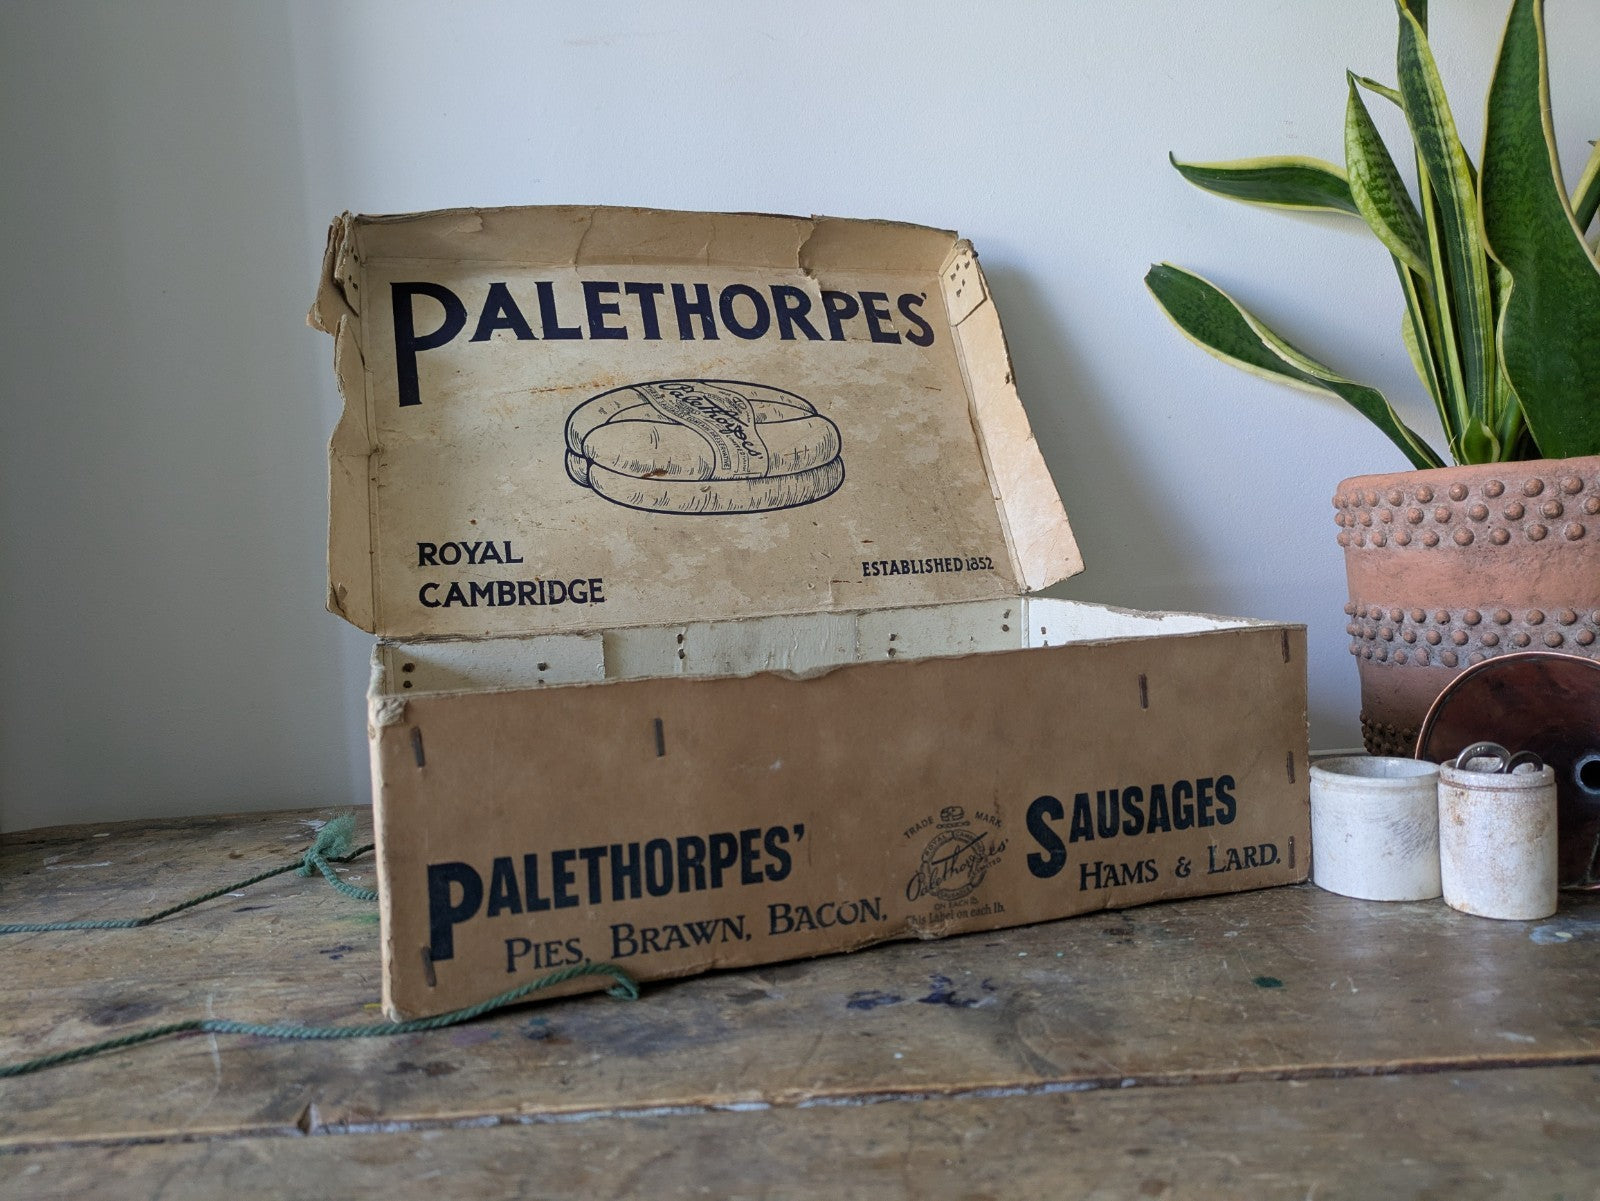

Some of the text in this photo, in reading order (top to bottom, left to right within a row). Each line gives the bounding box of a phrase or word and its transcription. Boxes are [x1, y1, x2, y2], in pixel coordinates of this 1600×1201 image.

[390, 280, 935, 407] PALETHORPES'
[416, 541, 524, 566] ROYAL
[862, 557, 995, 576] ESTABLISHED 1852
[418, 578, 606, 608] CAMBRIDGE
[904, 811, 1003, 839] TRADE MARK
[1026, 774, 1237, 879] SAUSAGES
[1079, 842, 1282, 892] HAMS & LARD.
[427, 823, 806, 962] PALETHORPES'
[956, 908, 969, 918] on
[970, 903, 992, 916] each
